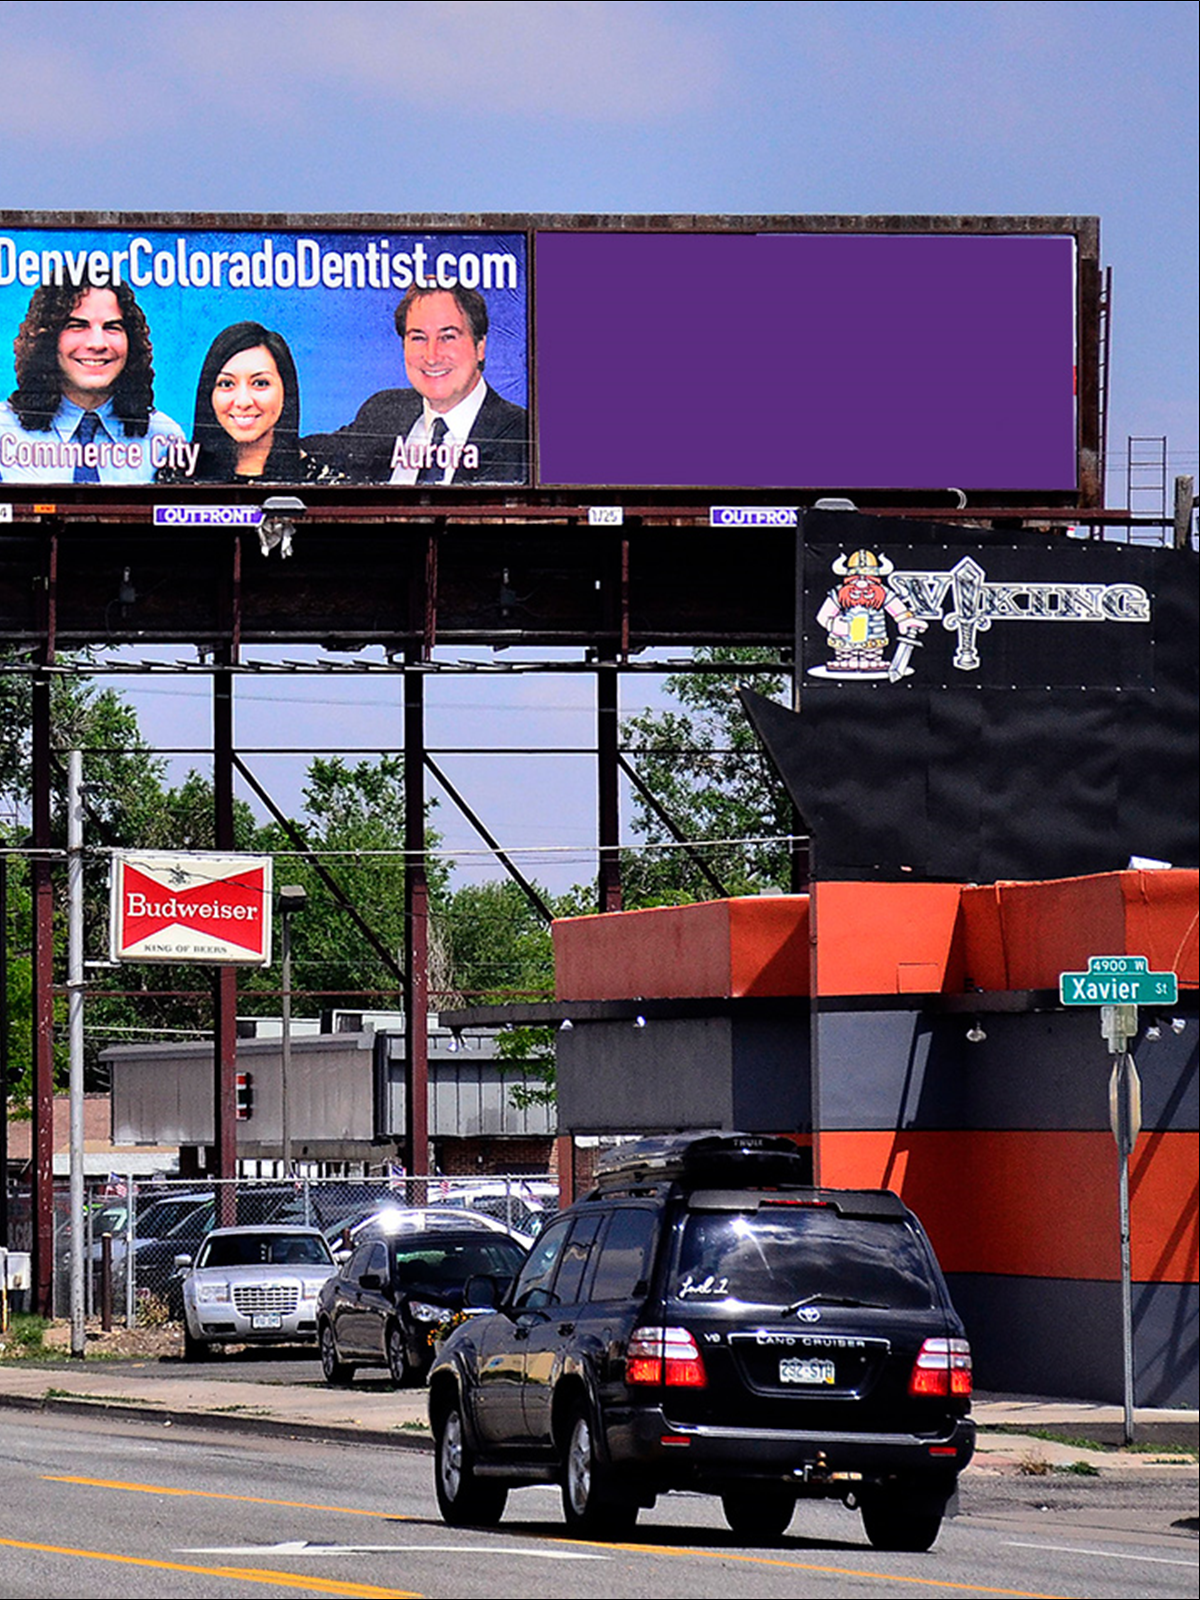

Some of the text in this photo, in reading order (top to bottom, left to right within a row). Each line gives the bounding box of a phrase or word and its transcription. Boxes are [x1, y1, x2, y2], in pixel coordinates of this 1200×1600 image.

[0, 434, 200, 476] Commerce City
[390, 434, 479, 470] Aurora
[164, 508, 256, 523] OUTFRONT
[721, 509, 798, 523] OUTFRON
[127, 892, 258, 920] Budweiser
[144, 944, 227, 954] KING OF BEERS
[1093, 960, 1144, 972] 4900 W
[1072, 978, 1167, 999] Xavier St
[756, 1334, 866, 1349] LAND CRUISER
